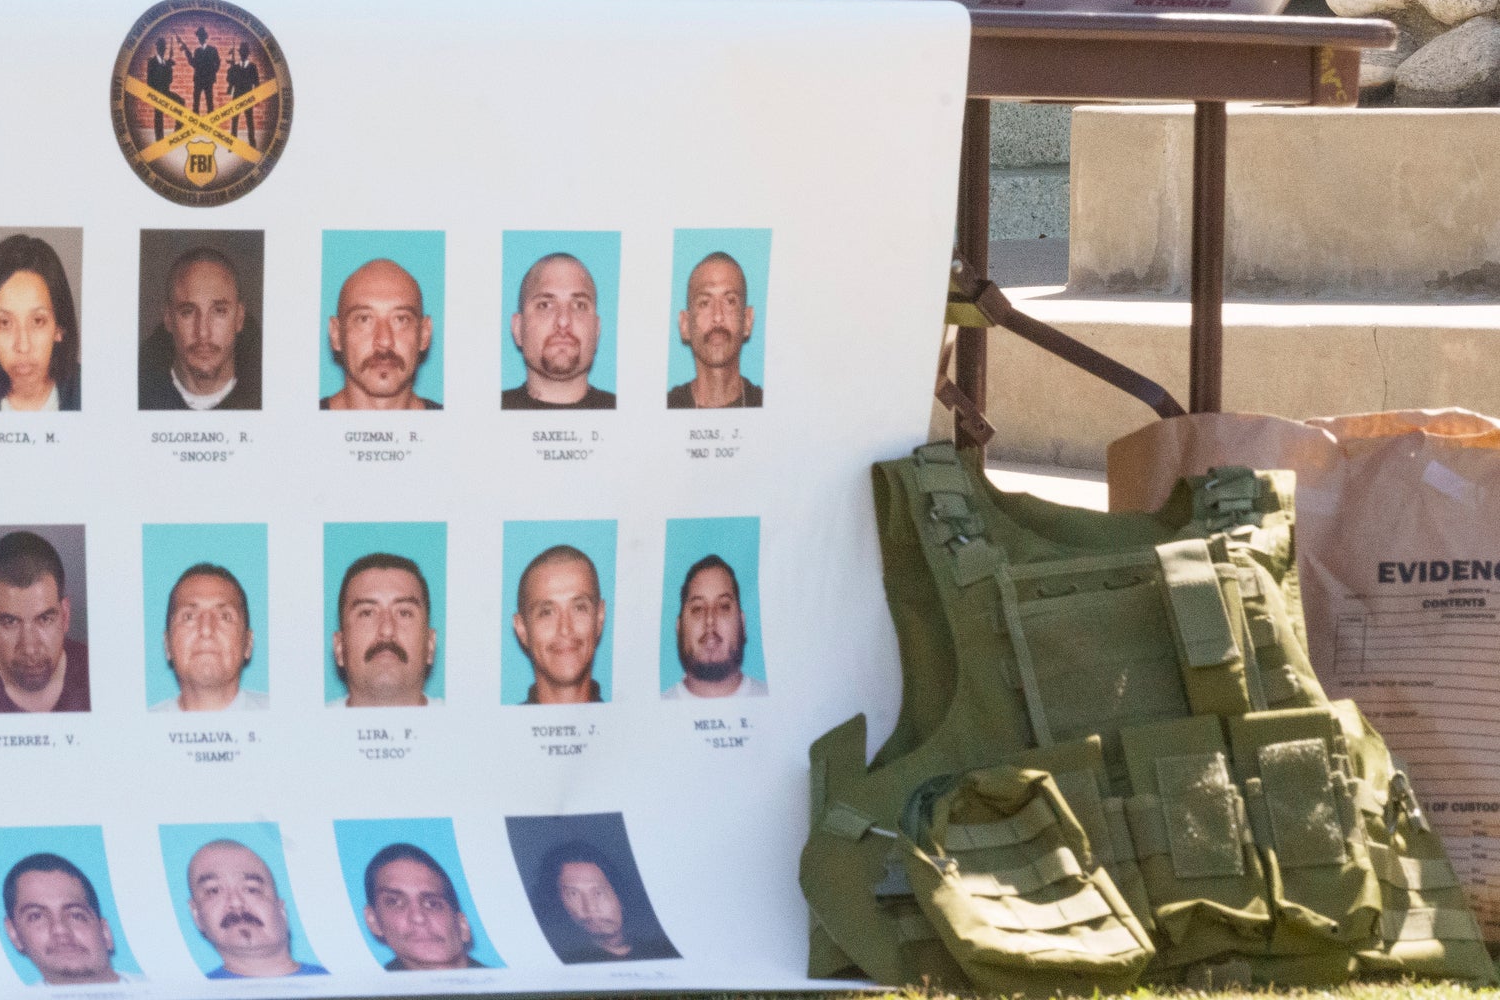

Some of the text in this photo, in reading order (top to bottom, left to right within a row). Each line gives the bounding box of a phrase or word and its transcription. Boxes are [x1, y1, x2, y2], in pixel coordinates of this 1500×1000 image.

[146, 92, 170, 109] POLICE
[188, 116, 199, 125] DO
[199, 122, 213, 133] NOT
[220, 107, 234, 117] NOT
[190, 154, 213, 173] FBI
[45, 432, 61, 445] M.
[151, 431, 254, 445] SOLORZANO, R.
[344, 431, 424, 445] GUZMAN, R.
[532, 430, 604, 443] SAXELL, D.
[172, 450, 235, 463] "SNOOPS"
[349, 450, 413, 463] "PSYCHO"
[1378, 560, 1500, 584] EVIDEN
[1422, 598, 1487, 609] CONTENTS
[65, 734, 81, 747] V.
[168, 731, 262, 745] VILLALVA, S.
[357, 728, 418, 742] LIRA, F.
[1432, 802, 1447, 812] OF
[1451, 802, 1500, 813] CUSTOD
